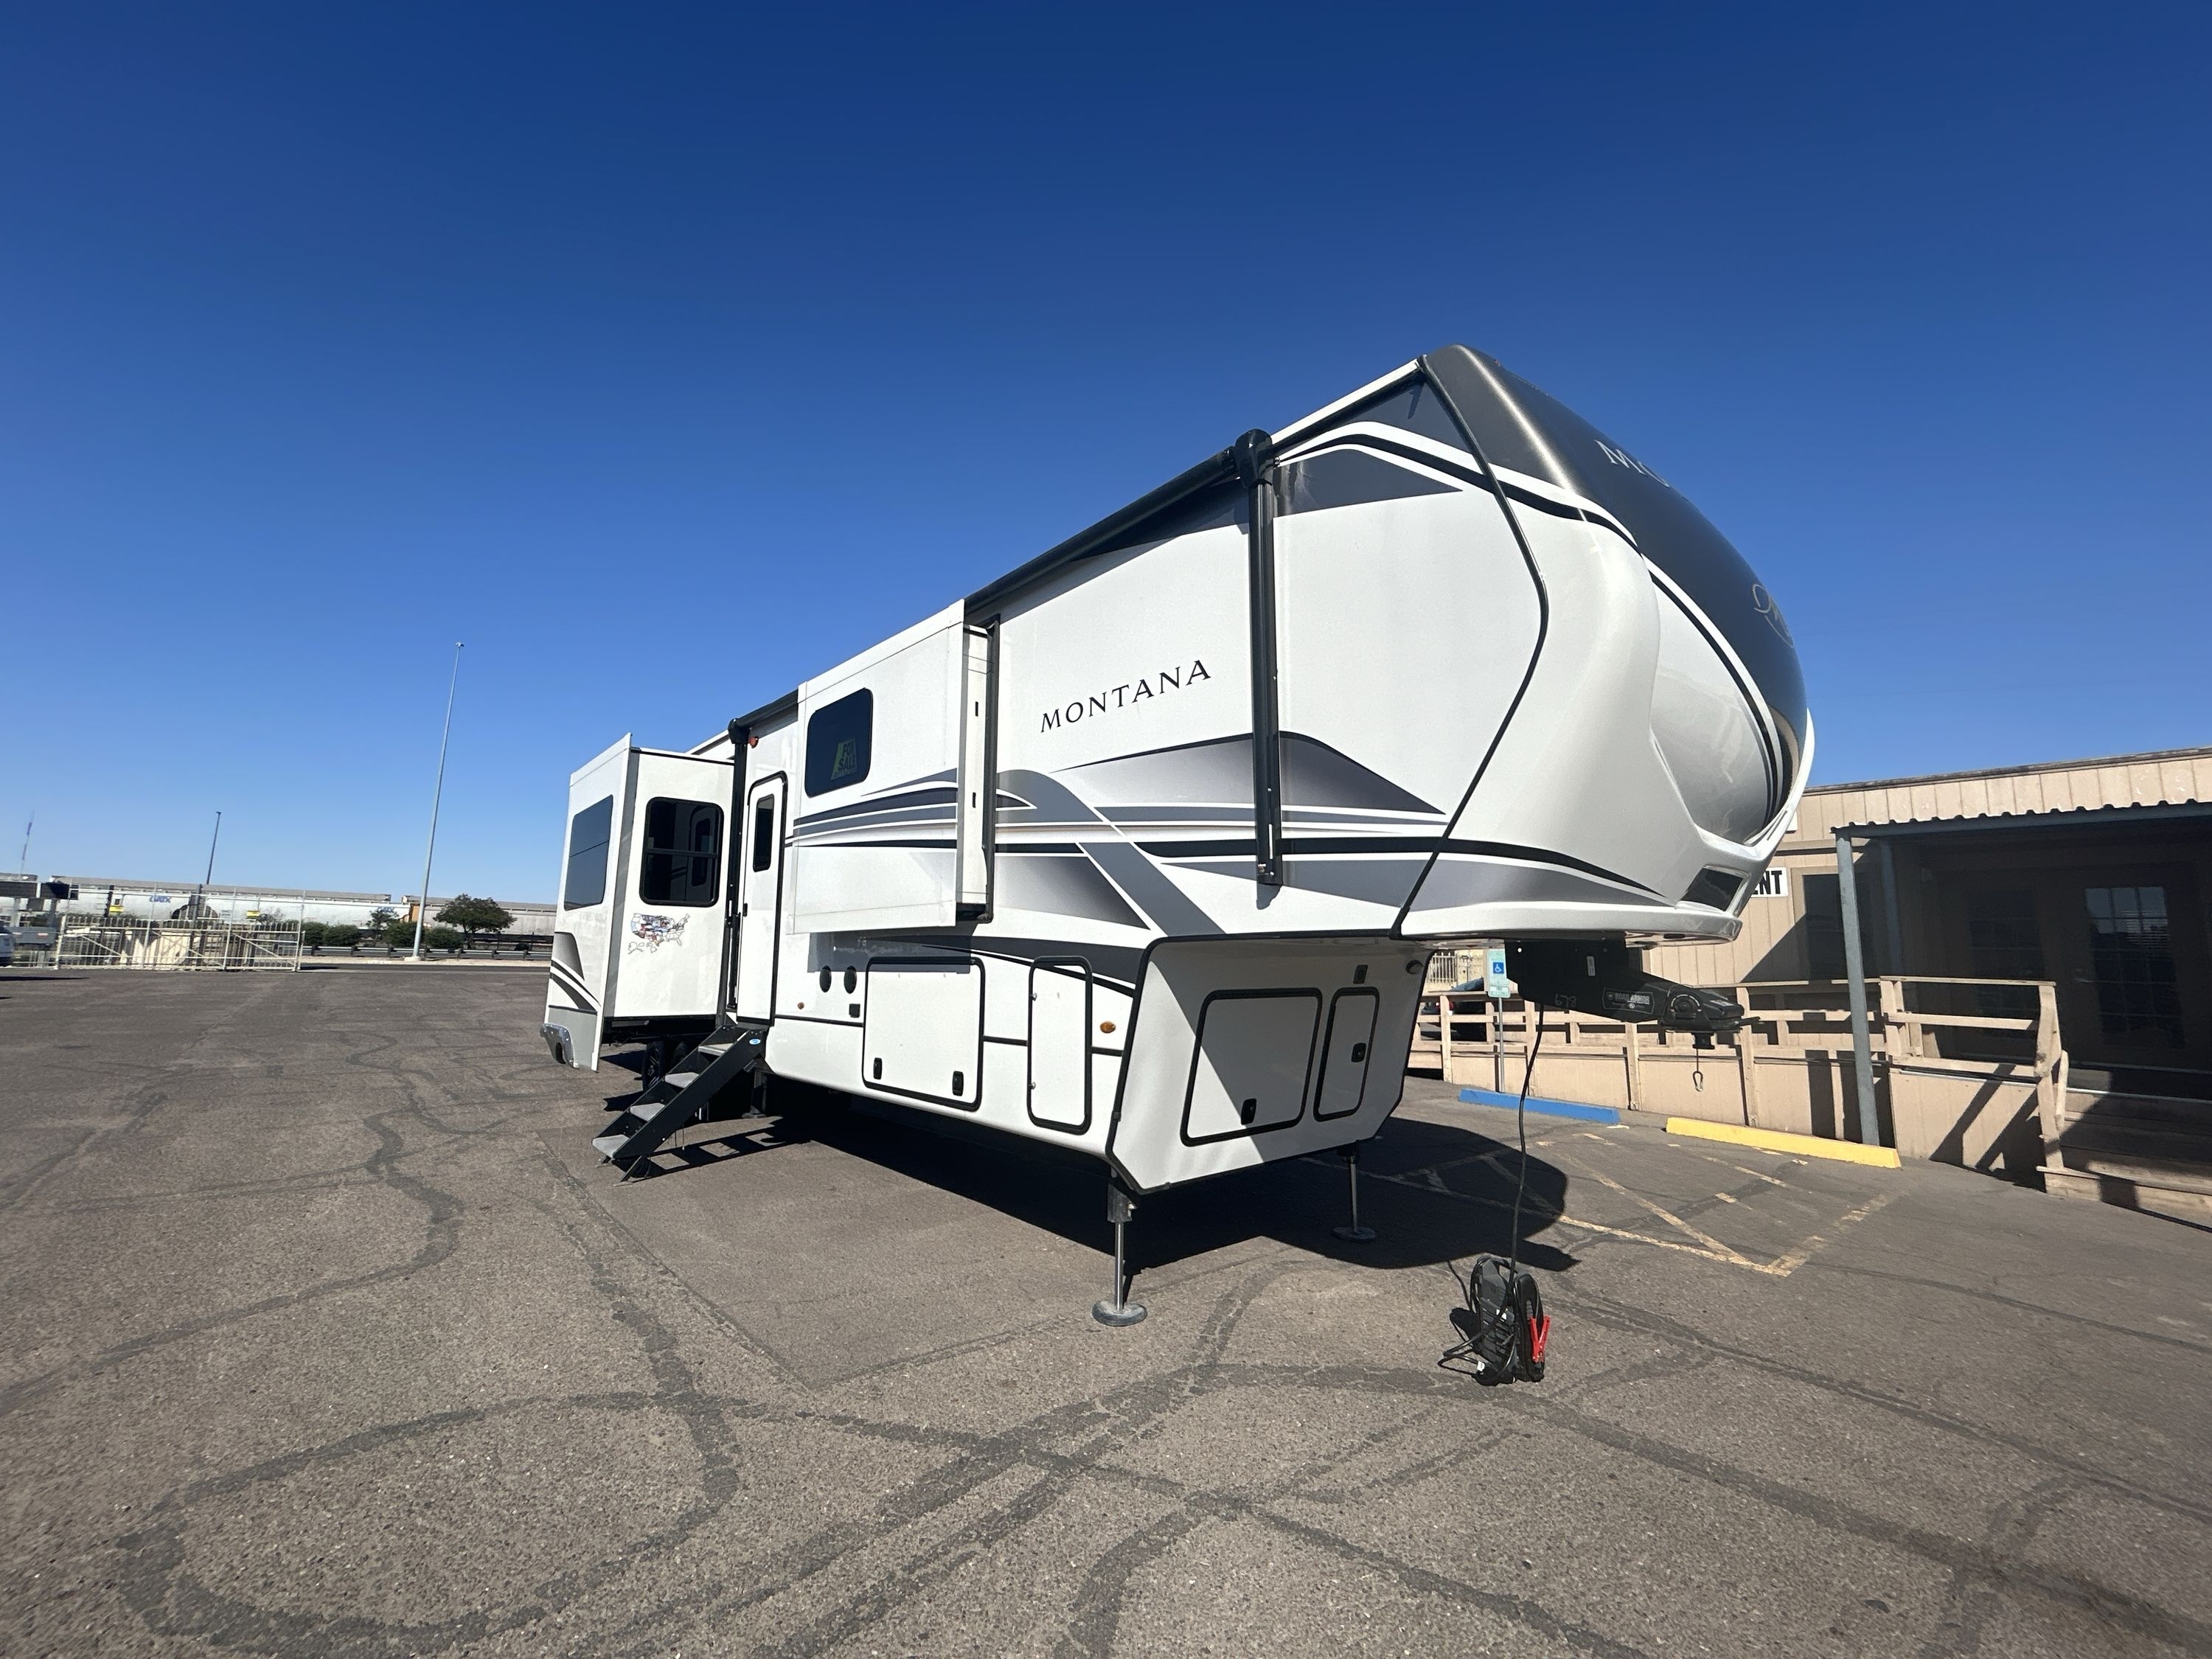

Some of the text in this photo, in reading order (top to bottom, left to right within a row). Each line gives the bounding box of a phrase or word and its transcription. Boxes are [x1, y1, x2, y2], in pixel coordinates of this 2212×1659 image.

[1040, 659, 1211, 733] MONTANA
[837, 754, 855, 770] SALE
[1555, 993, 1576, 1008] 678
[1630, 994, 1649, 1004] ARMOR
